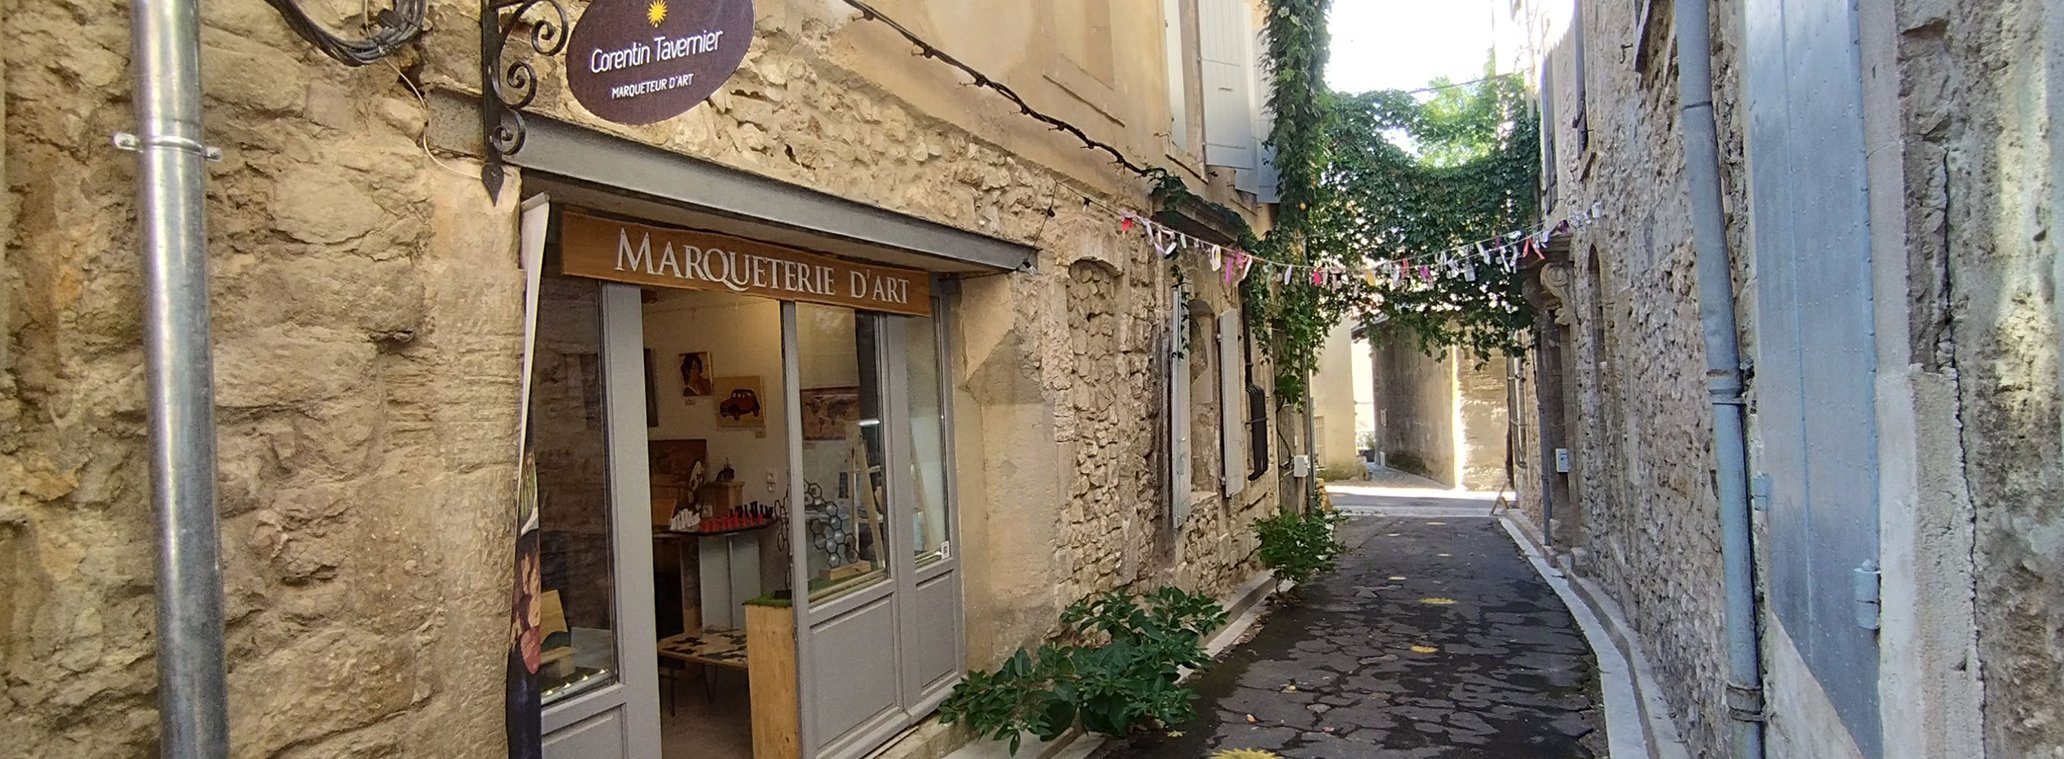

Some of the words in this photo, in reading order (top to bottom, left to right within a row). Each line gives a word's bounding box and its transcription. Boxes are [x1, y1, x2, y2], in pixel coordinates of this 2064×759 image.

[591, 42, 650, 73] Corentin
[654, 29, 723, 61] Tavernier
[611, 79, 667, 99] MARQUETEUR
[669, 73, 694, 89] D'ART
[614, 227, 836, 296] MARQUETERIE
[850, 269, 910, 304] D'ART
